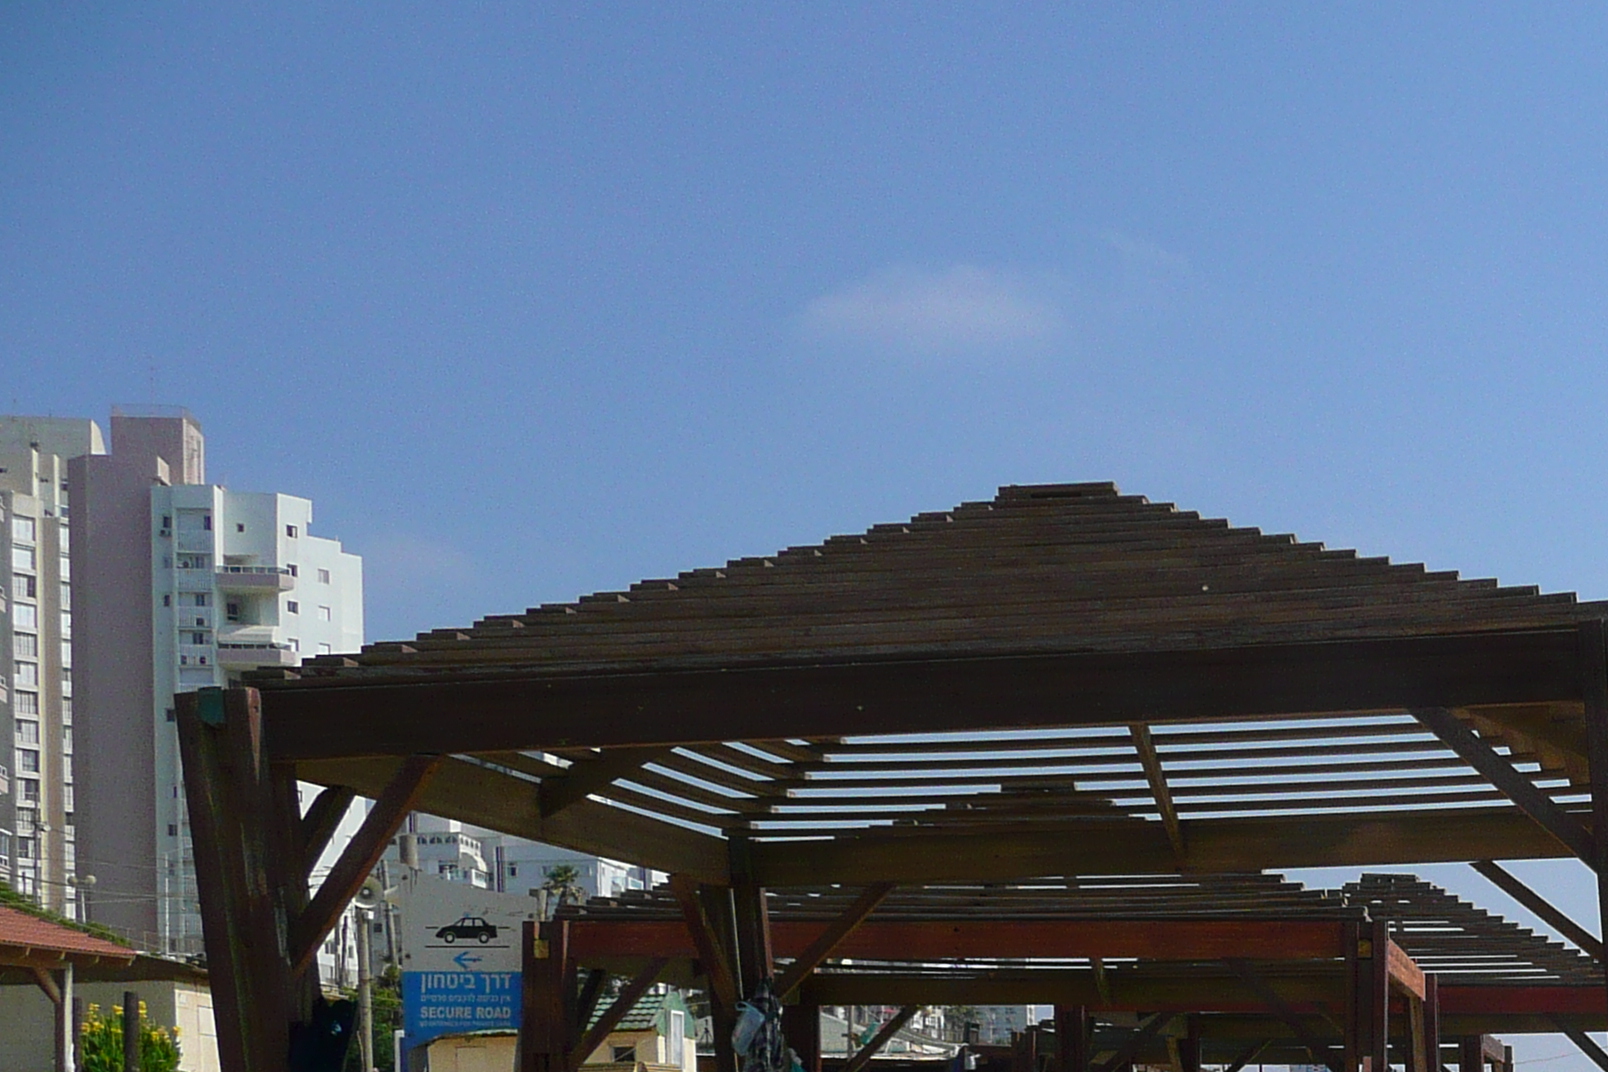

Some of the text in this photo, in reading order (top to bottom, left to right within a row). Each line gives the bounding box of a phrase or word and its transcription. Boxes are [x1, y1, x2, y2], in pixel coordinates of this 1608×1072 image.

[421, 974, 512, 994] דרך ביטחון
[420, 1006, 511, 1018] SECURE ROAD
